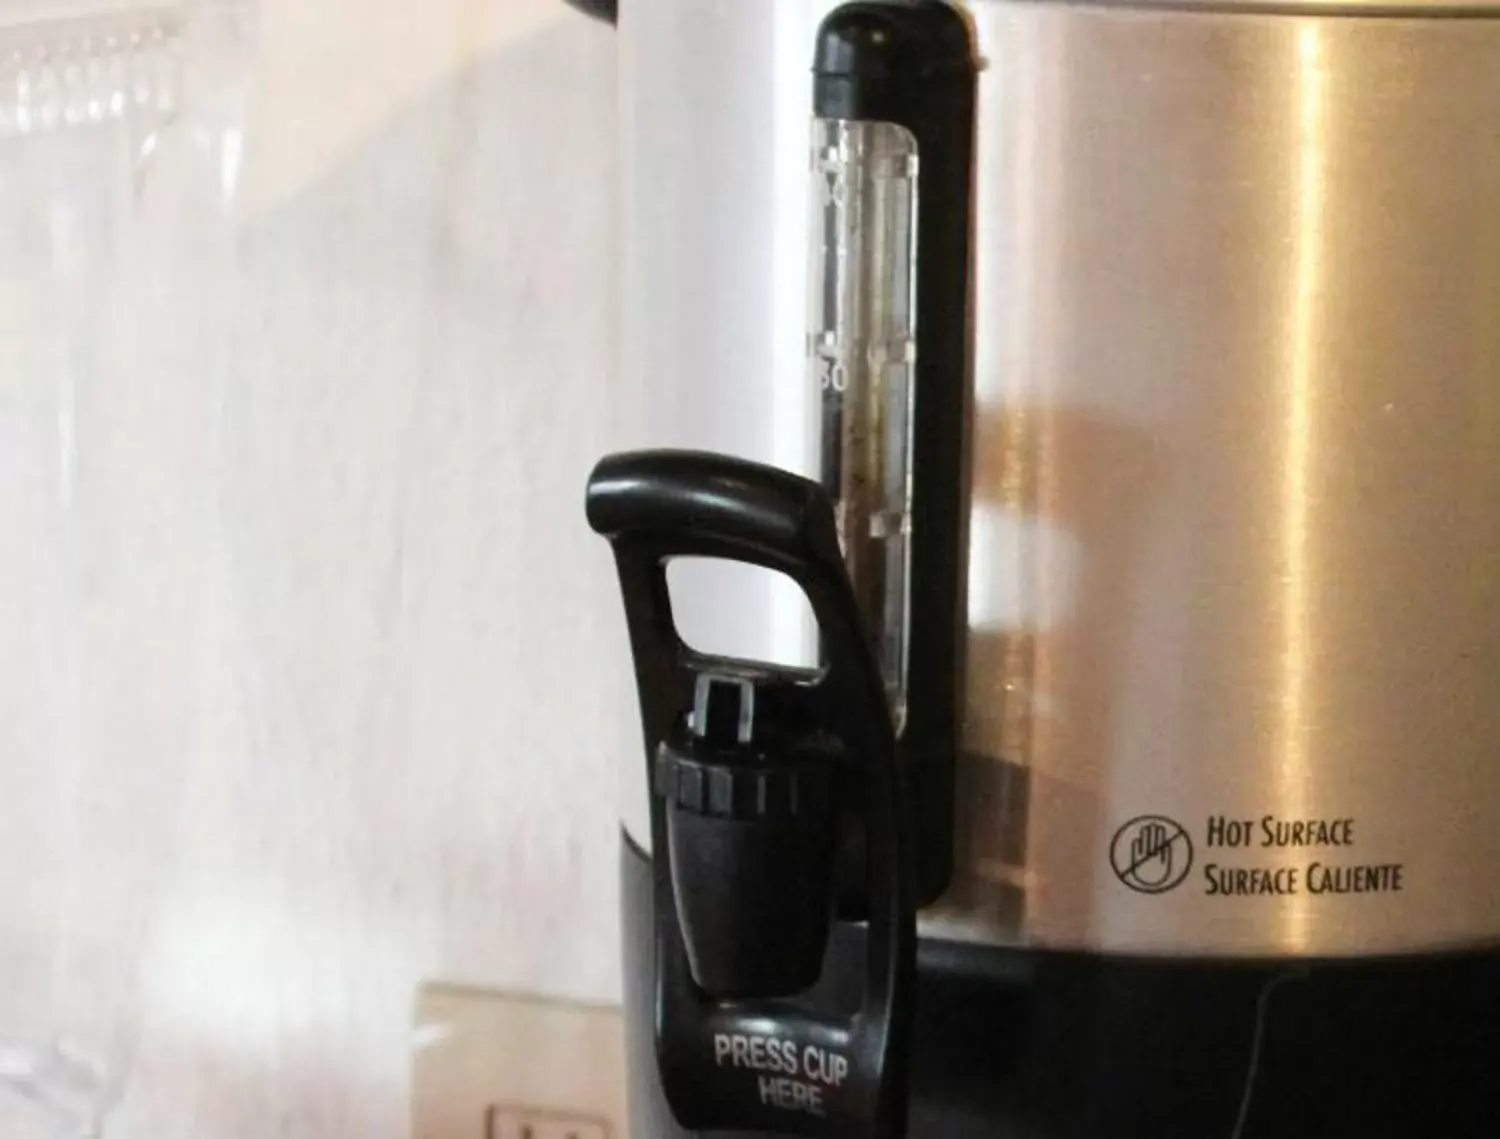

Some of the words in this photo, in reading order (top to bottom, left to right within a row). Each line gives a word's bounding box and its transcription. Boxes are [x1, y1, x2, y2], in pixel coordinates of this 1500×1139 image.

[713, 1033, 798, 1075] PRESS
[803, 1045, 848, 1088] CUP
[757, 1075, 827, 1119] HERE
